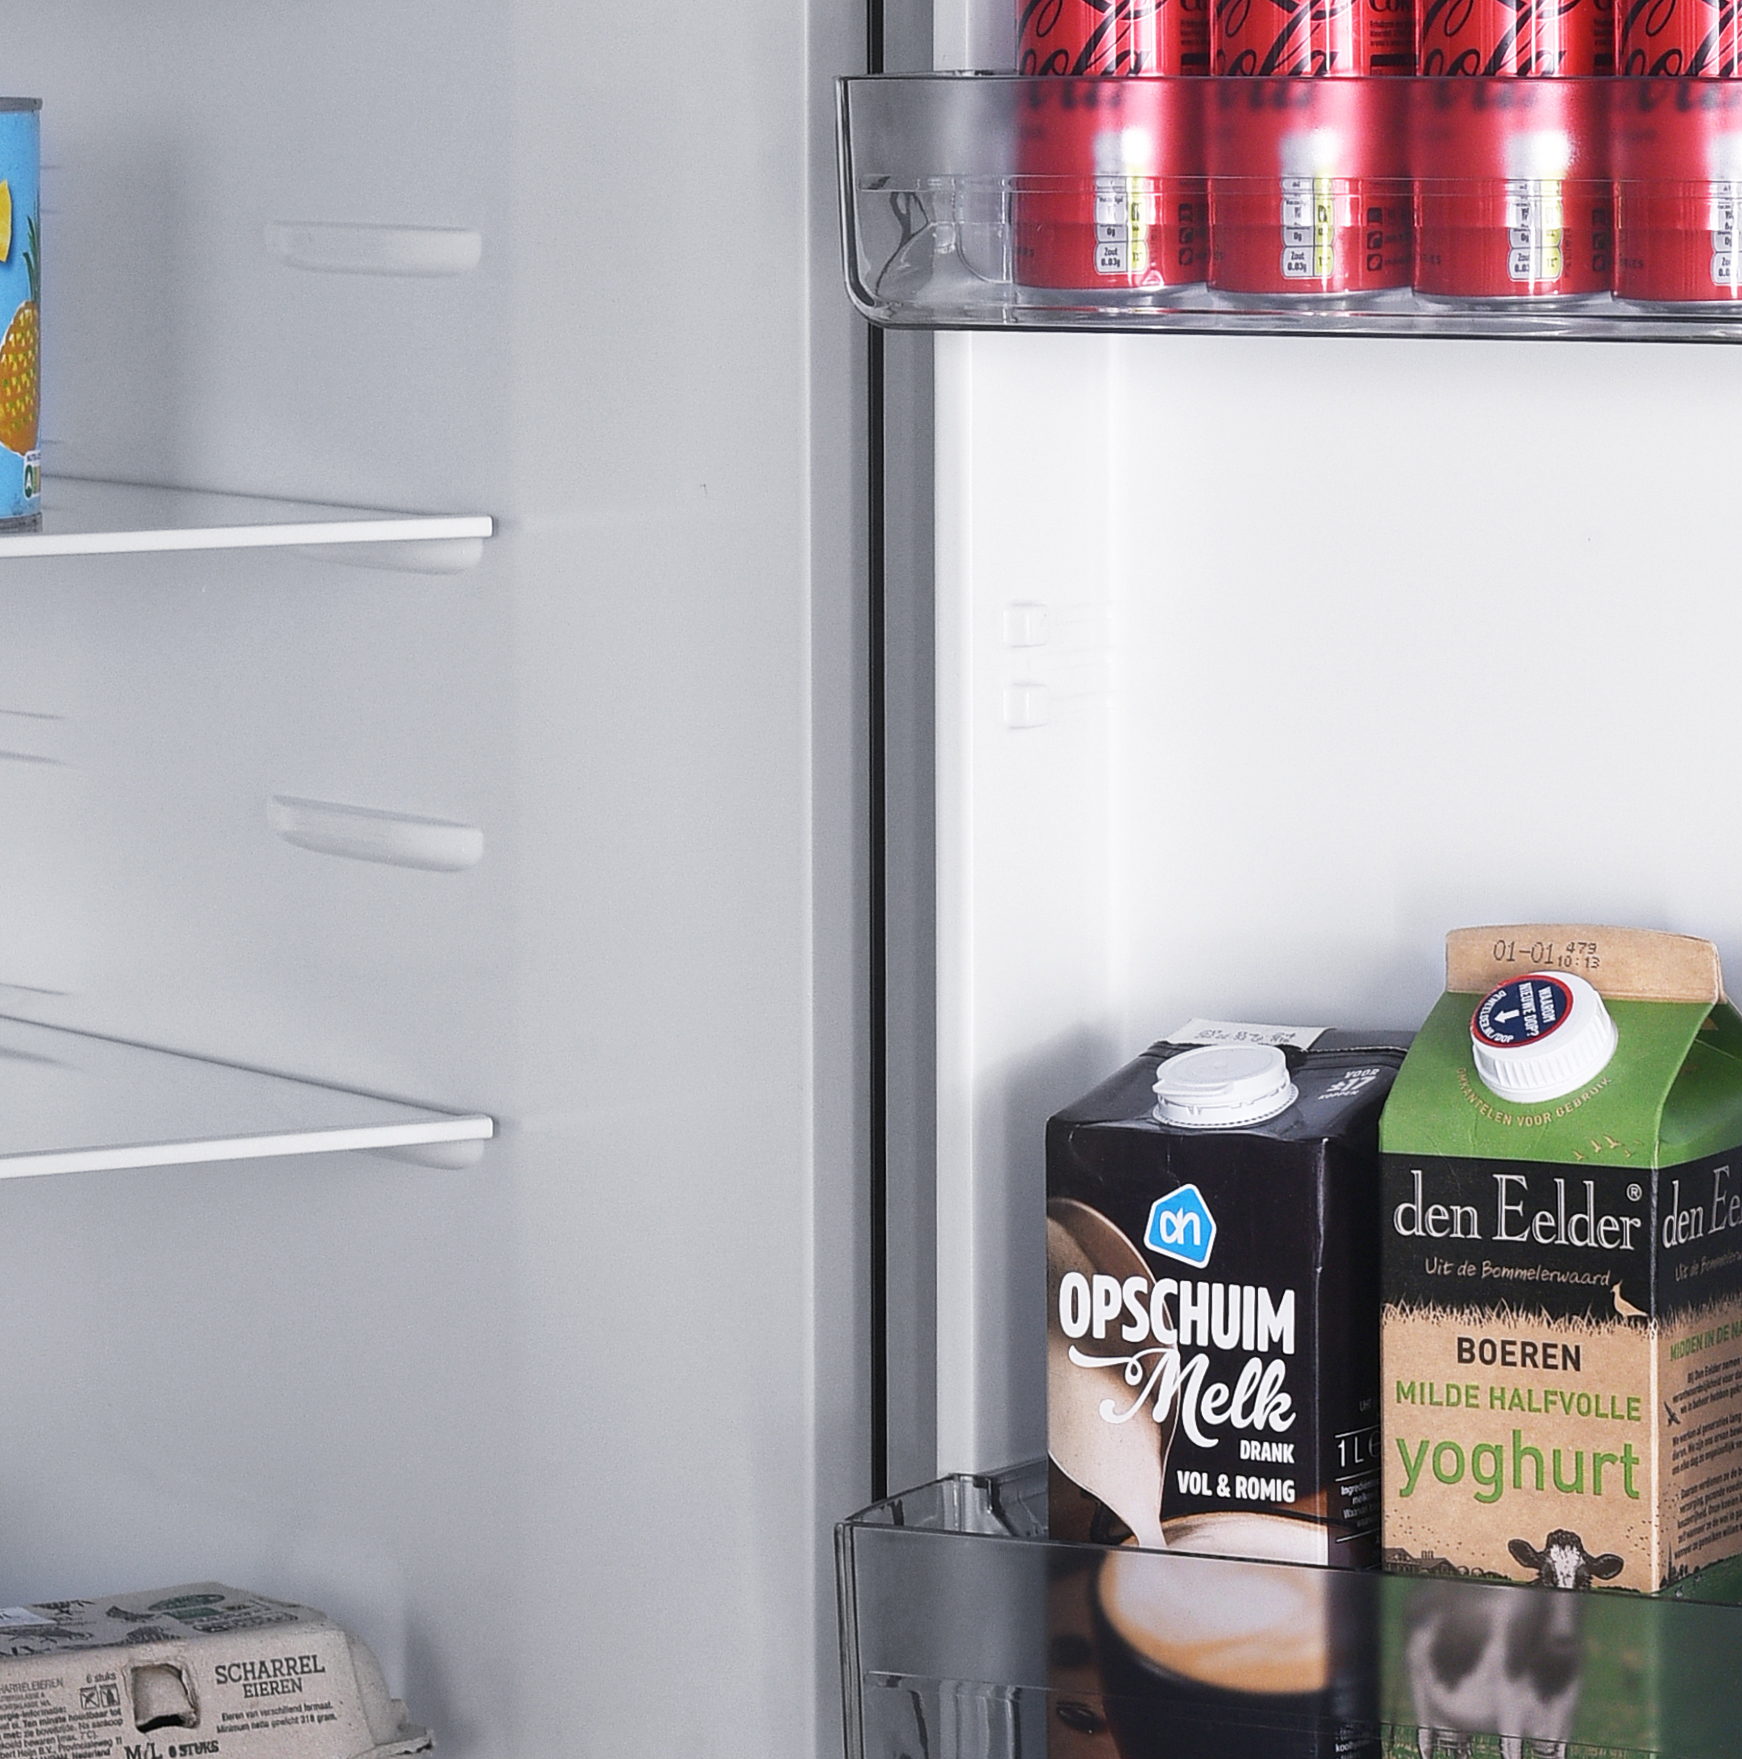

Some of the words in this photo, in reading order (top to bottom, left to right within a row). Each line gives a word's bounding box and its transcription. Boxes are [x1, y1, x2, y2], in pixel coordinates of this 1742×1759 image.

[1493, 939, 1555, 965] 01-01
[1566, 942, 1598, 955] 479
[1519, 982, 1537, 1015] NIEUWE
[1538, 986, 1556, 1023] WAAROM
[1455, 1066, 1513, 1126] OMKANTELEN
[1517, 1112, 1553, 1128] VOOR
[1555, 1076, 1612, 1118] GEBRUIK
[1394, 1170, 1482, 1241] den
[1493, 1174, 1642, 1252] Eelder
[1663, 1179, 1704, 1250] den
[1425, 1256, 1451, 1276] Uit
[1458, 1258, 1478, 1278] de
[1482, 1258, 1610, 1287] Bommelerwaard
[1059, 1271, 1296, 1356] OPSCHUIM
[1456, 1336, 1582, 1372] BOEREN
[1670, 1334, 1702, 1362] MIDDEN
[1069, 1344, 1297, 1448] Melk
[1396, 1379, 1480, 1409] MILDE
[1490, 1386, 1642, 1423] HALFVOLLE
[1240, 1438, 1295, 1465] DRANK
[1398, 1430, 1641, 1504] yoghurt
[1177, 1470, 1213, 1498] VOL
[1216, 1473, 1232, 1499] &
[1235, 1475, 1296, 1505] ROMIG
[93, 1672, 117, 1683] stuks
[215, 1654, 325, 1685] SCHARREL
[243, 1677, 303, 1699] EIEREN
[179, 1740, 220, 1757] STUKS
